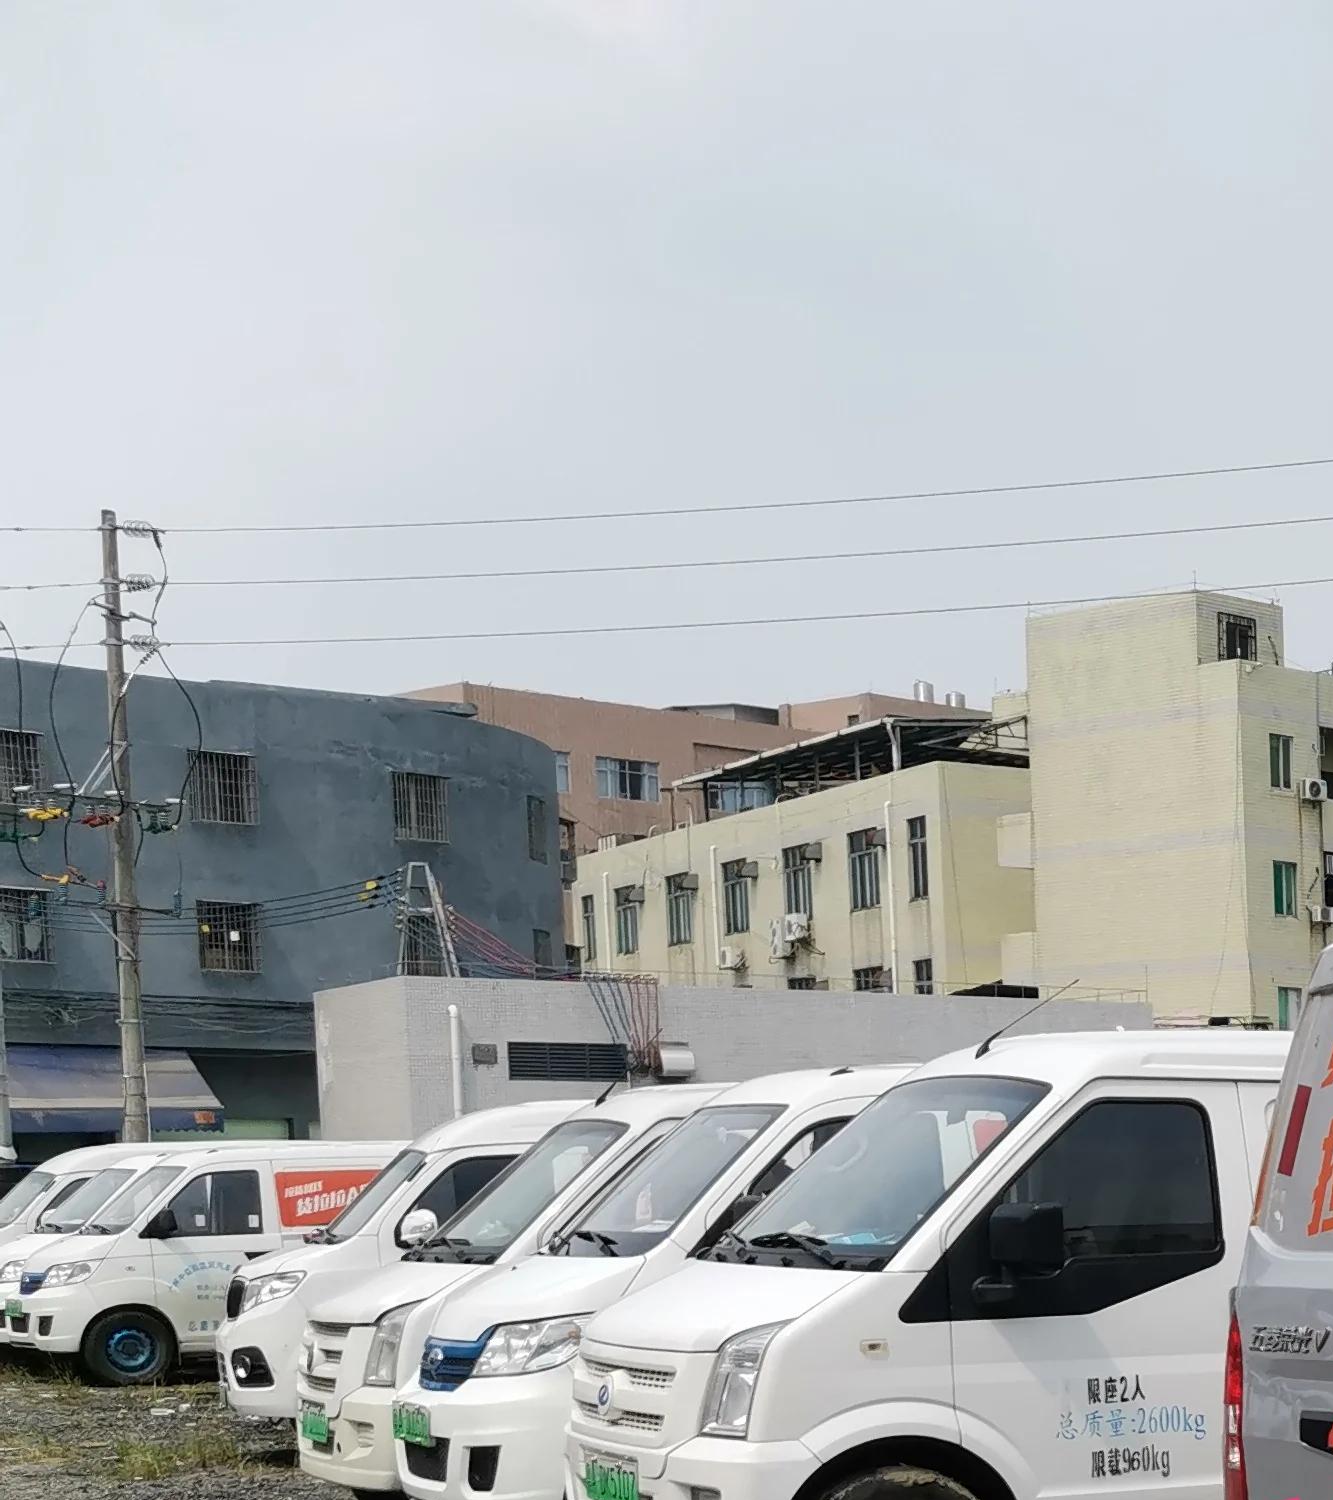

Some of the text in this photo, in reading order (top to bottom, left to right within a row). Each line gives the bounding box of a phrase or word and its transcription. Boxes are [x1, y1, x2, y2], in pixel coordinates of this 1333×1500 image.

[1087, 1374, 1146, 1405] 限座2人
[1091, 1444, 1171, 1478] 限载960kg
